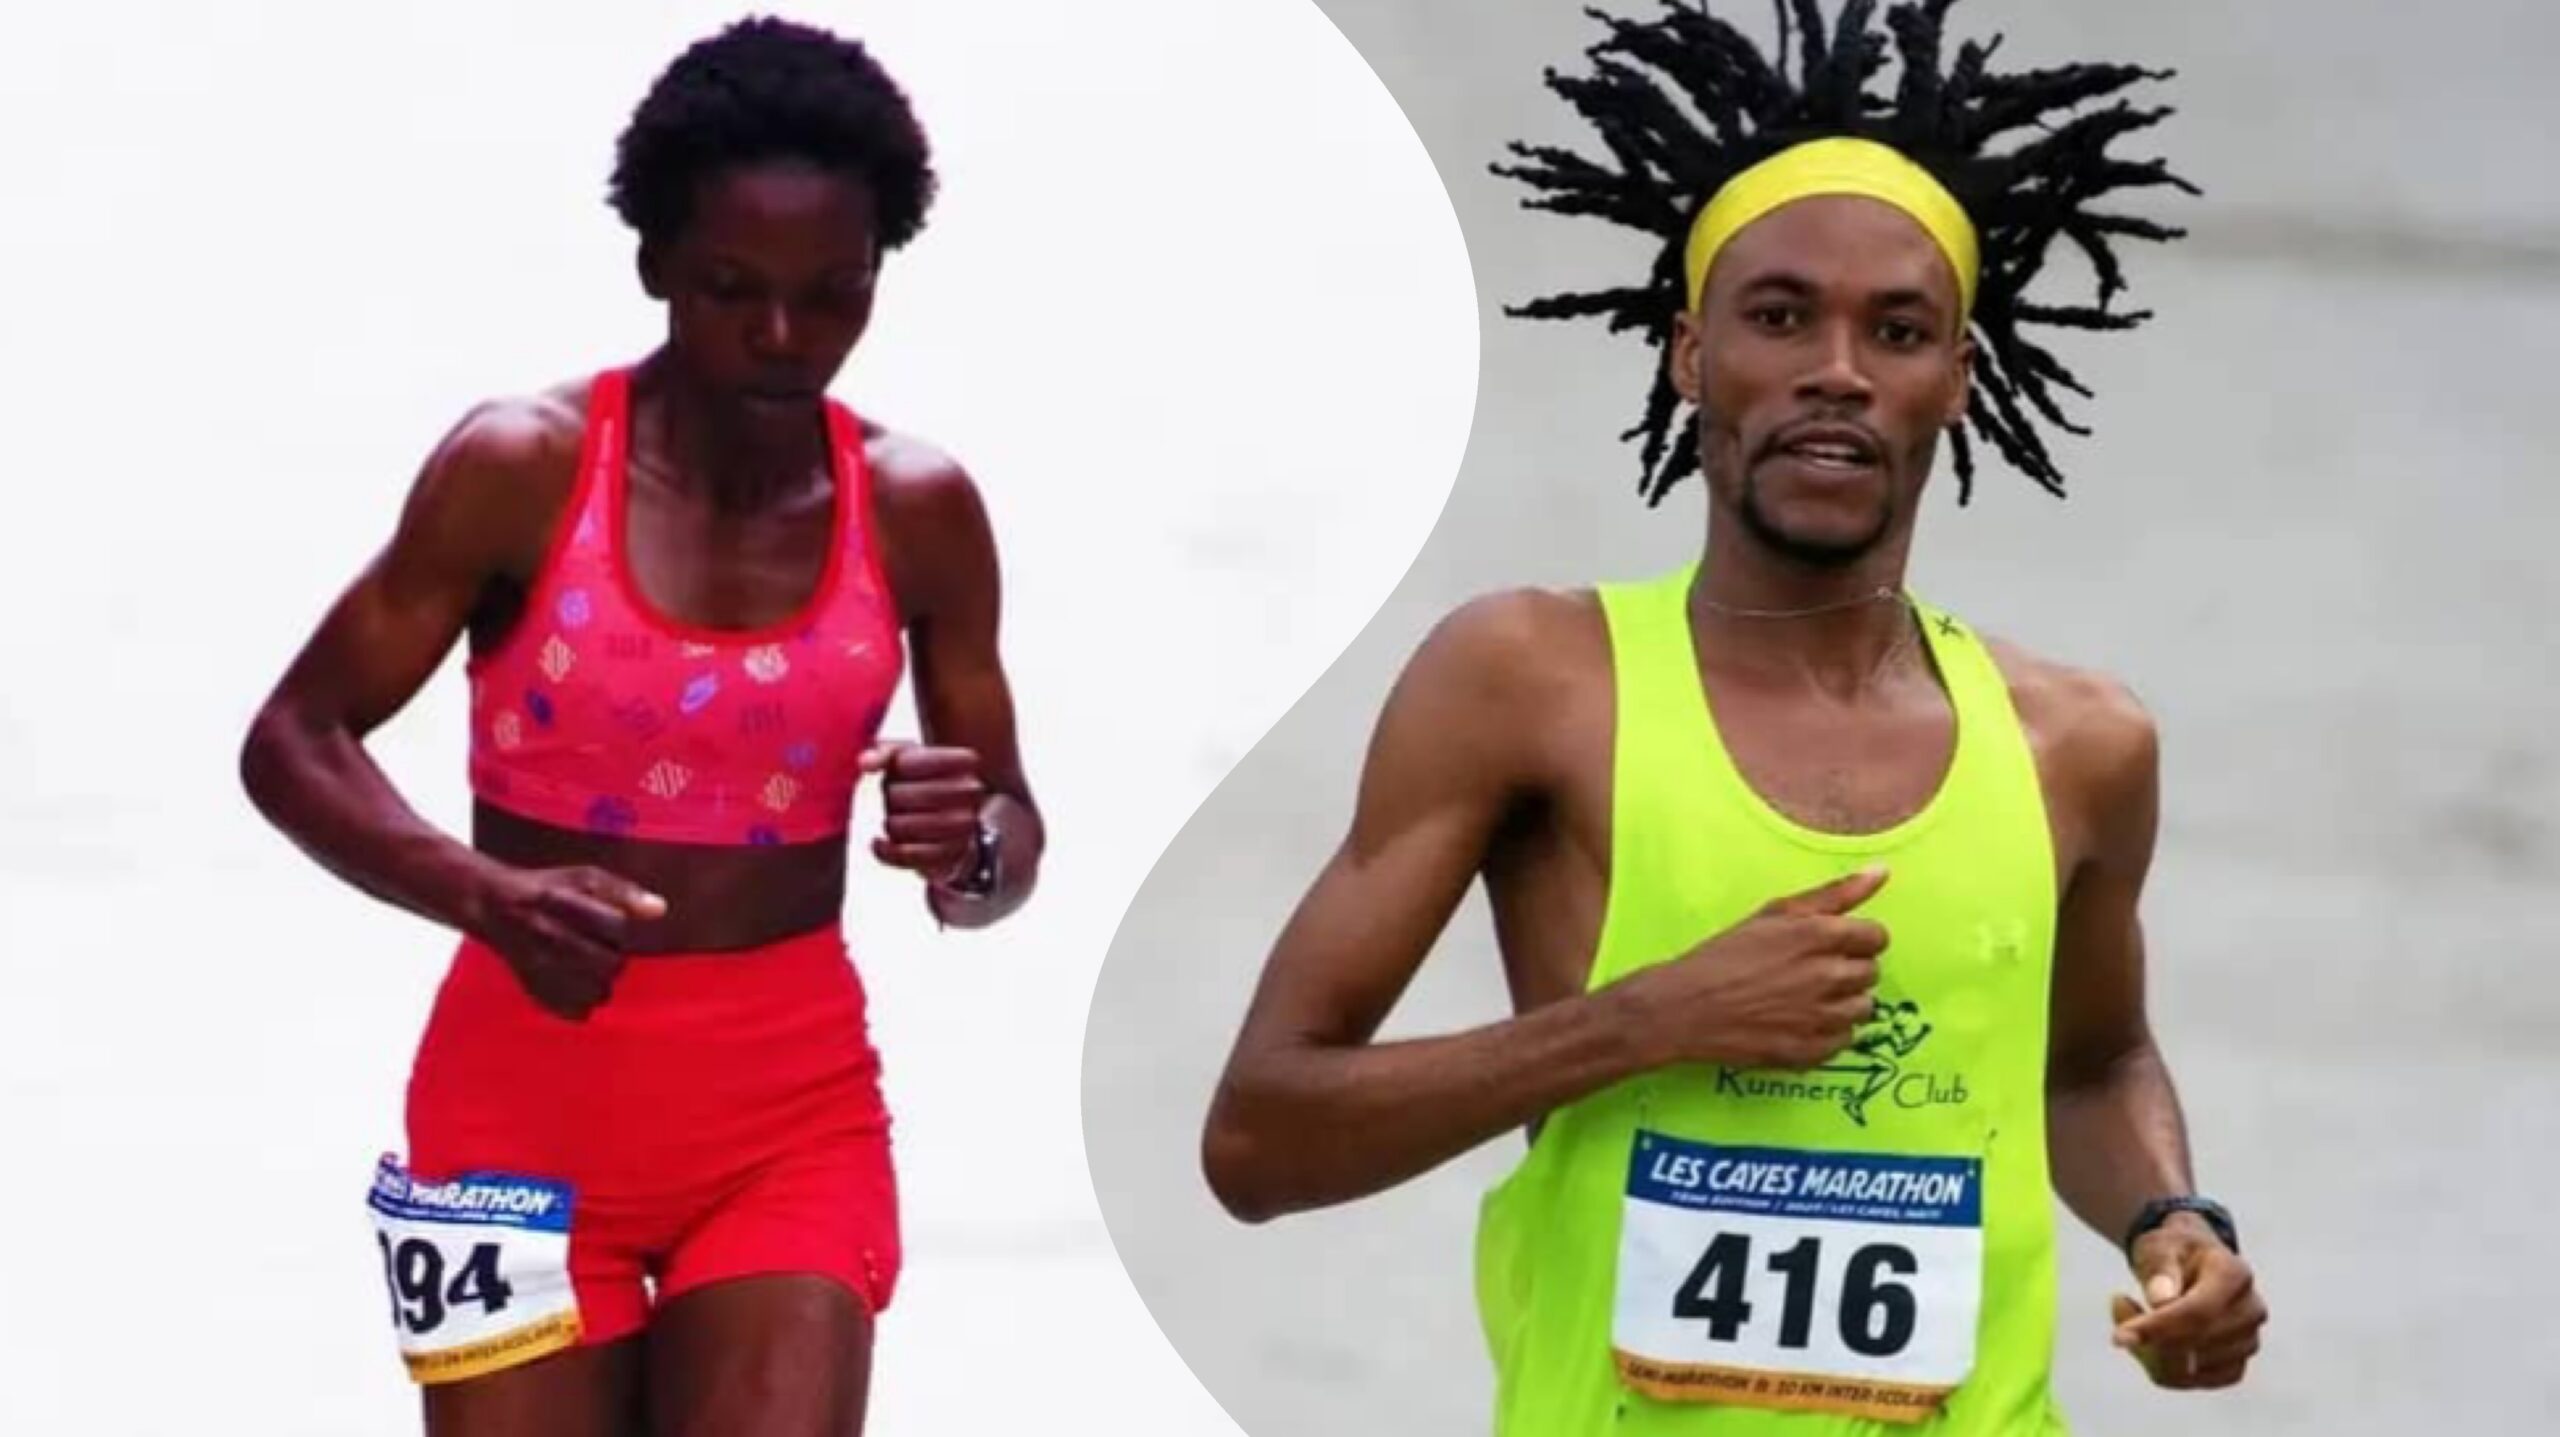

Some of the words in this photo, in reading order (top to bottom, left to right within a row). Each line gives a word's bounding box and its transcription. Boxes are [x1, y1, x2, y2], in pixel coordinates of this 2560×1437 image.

[1893, 1072, 1969, 1109] Club
[1650, 1151, 1704, 1188] LES
[1708, 1160, 1800, 1194] CAYES
[1800, 1169, 1965, 1206] MARATHON
[1672, 1231, 1918, 1358] 416
